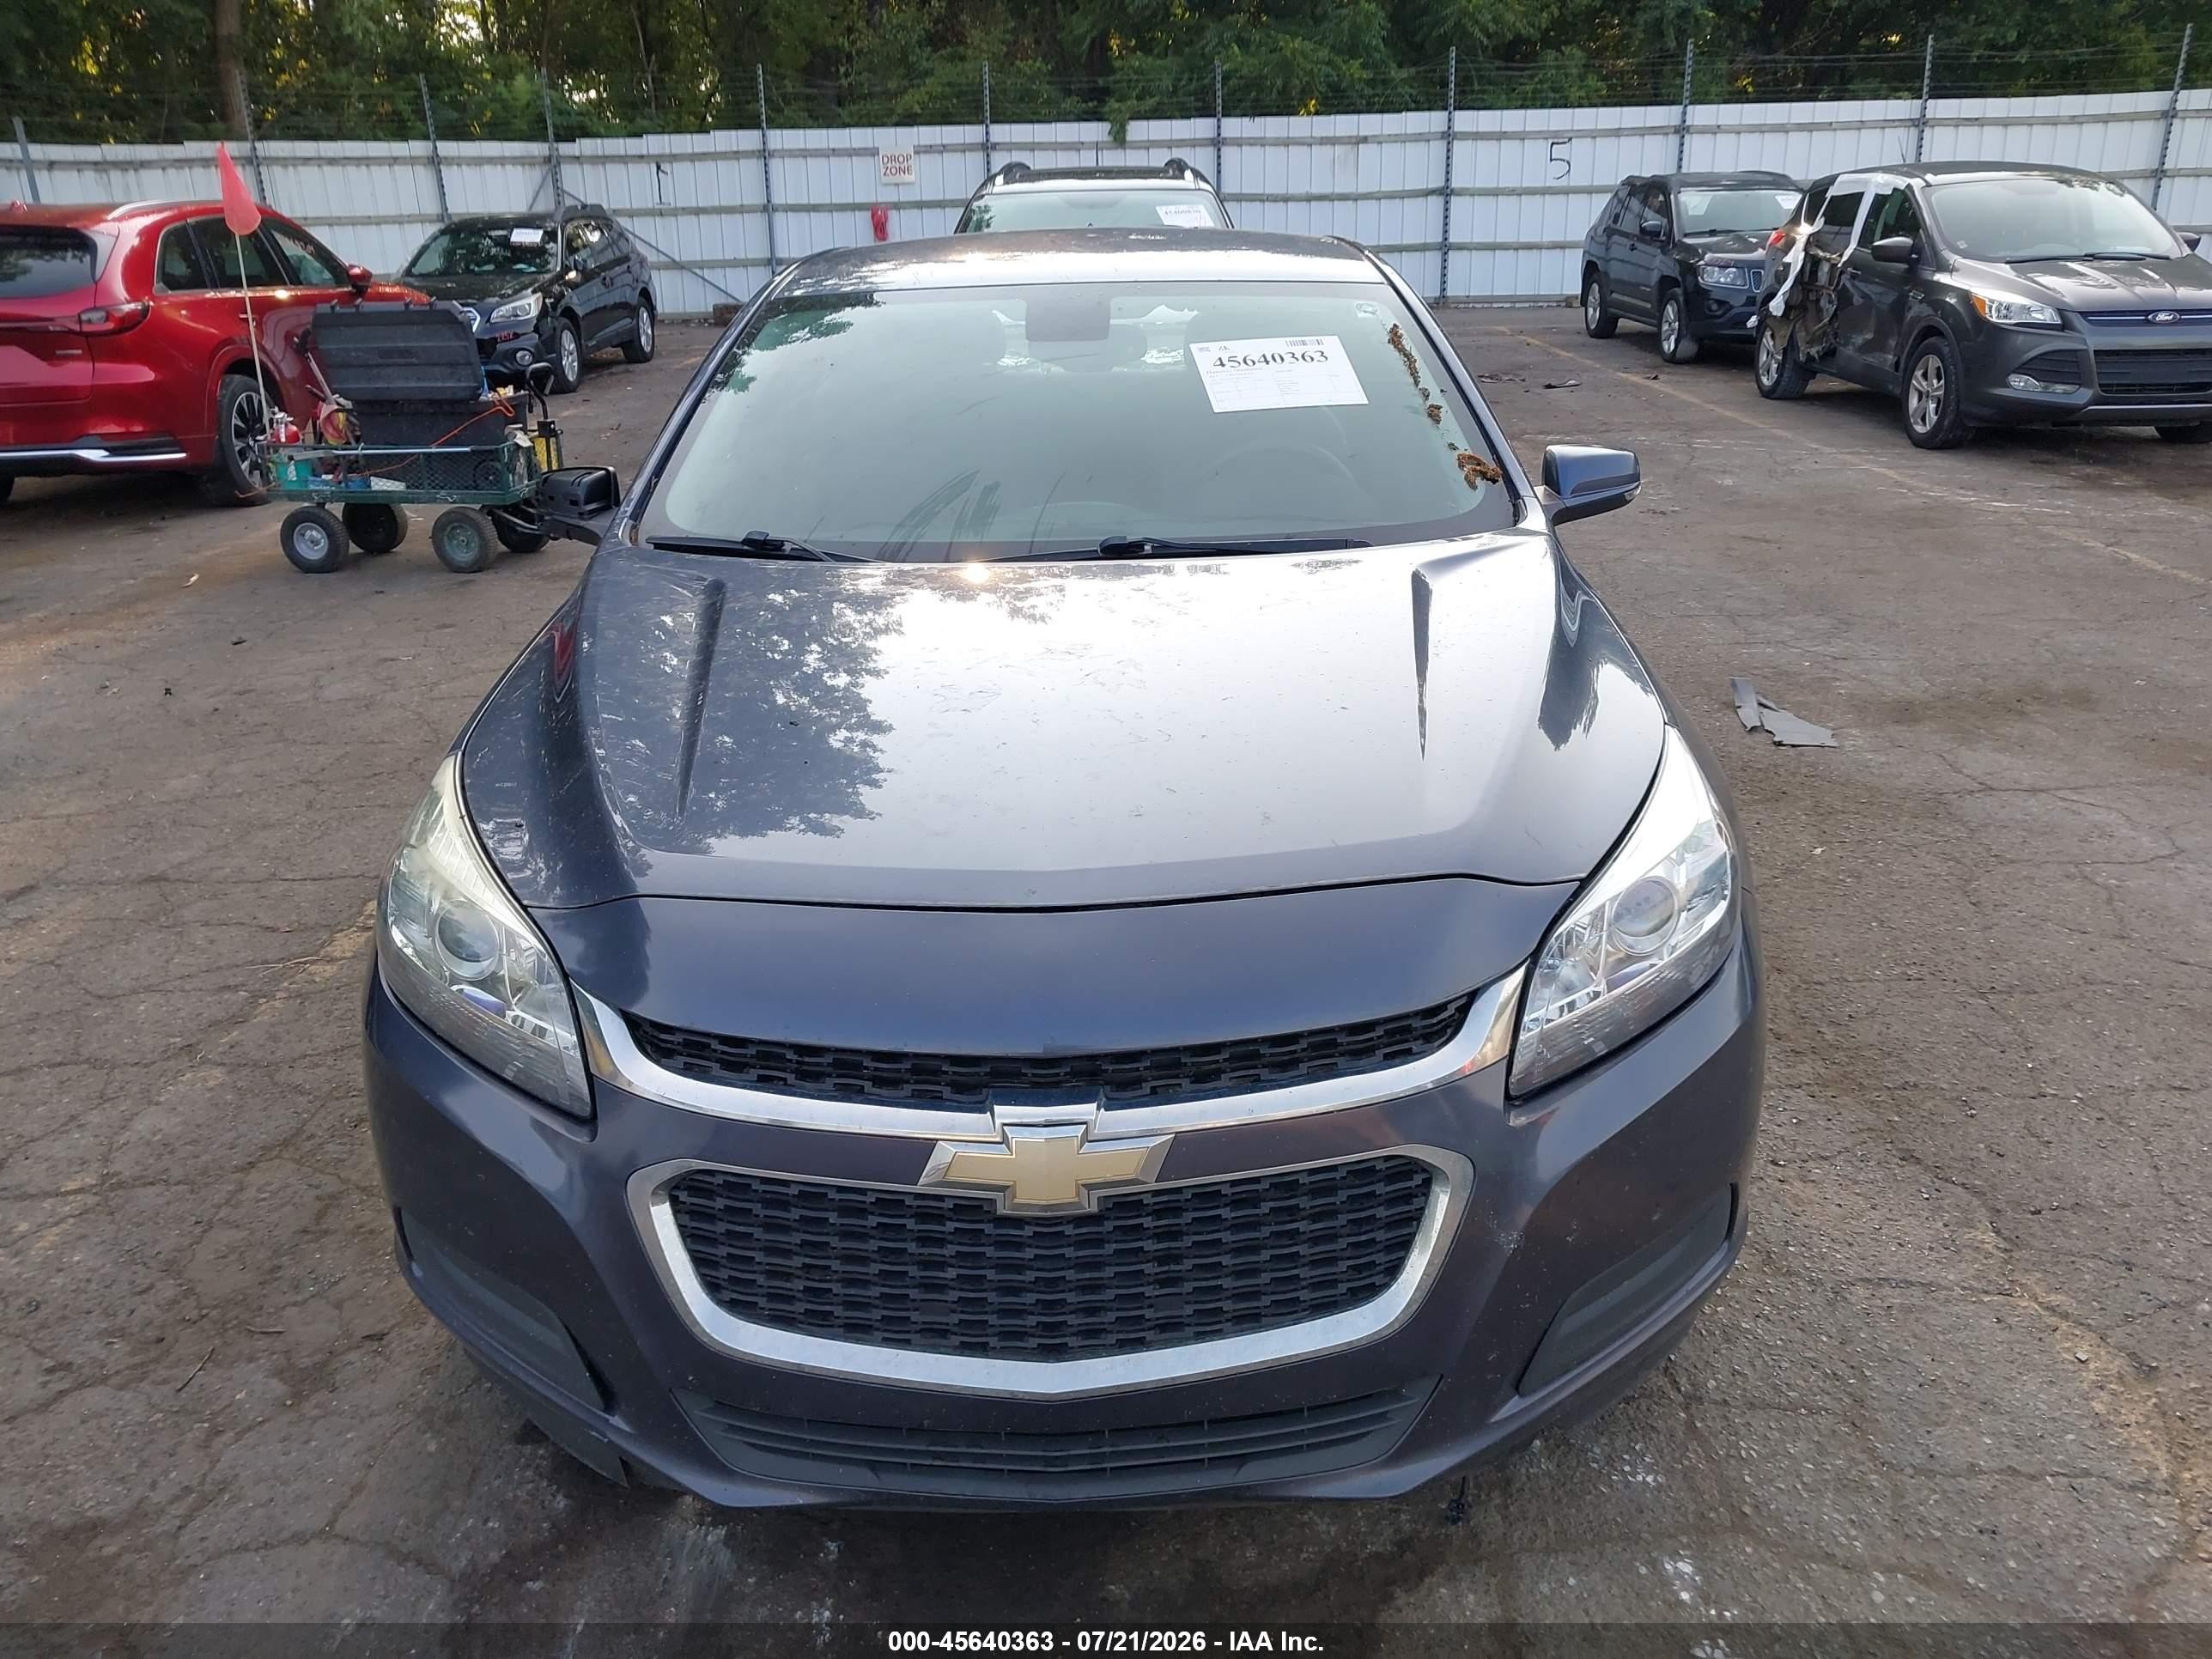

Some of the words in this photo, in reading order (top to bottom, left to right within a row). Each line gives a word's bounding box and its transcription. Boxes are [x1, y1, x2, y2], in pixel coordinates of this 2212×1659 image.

[882, 155, 912, 165] DROP
[1550, 137, 1571, 179] 5
[883, 165, 913, 176] ZONE
[1212, 349, 1329, 368] 45640363
